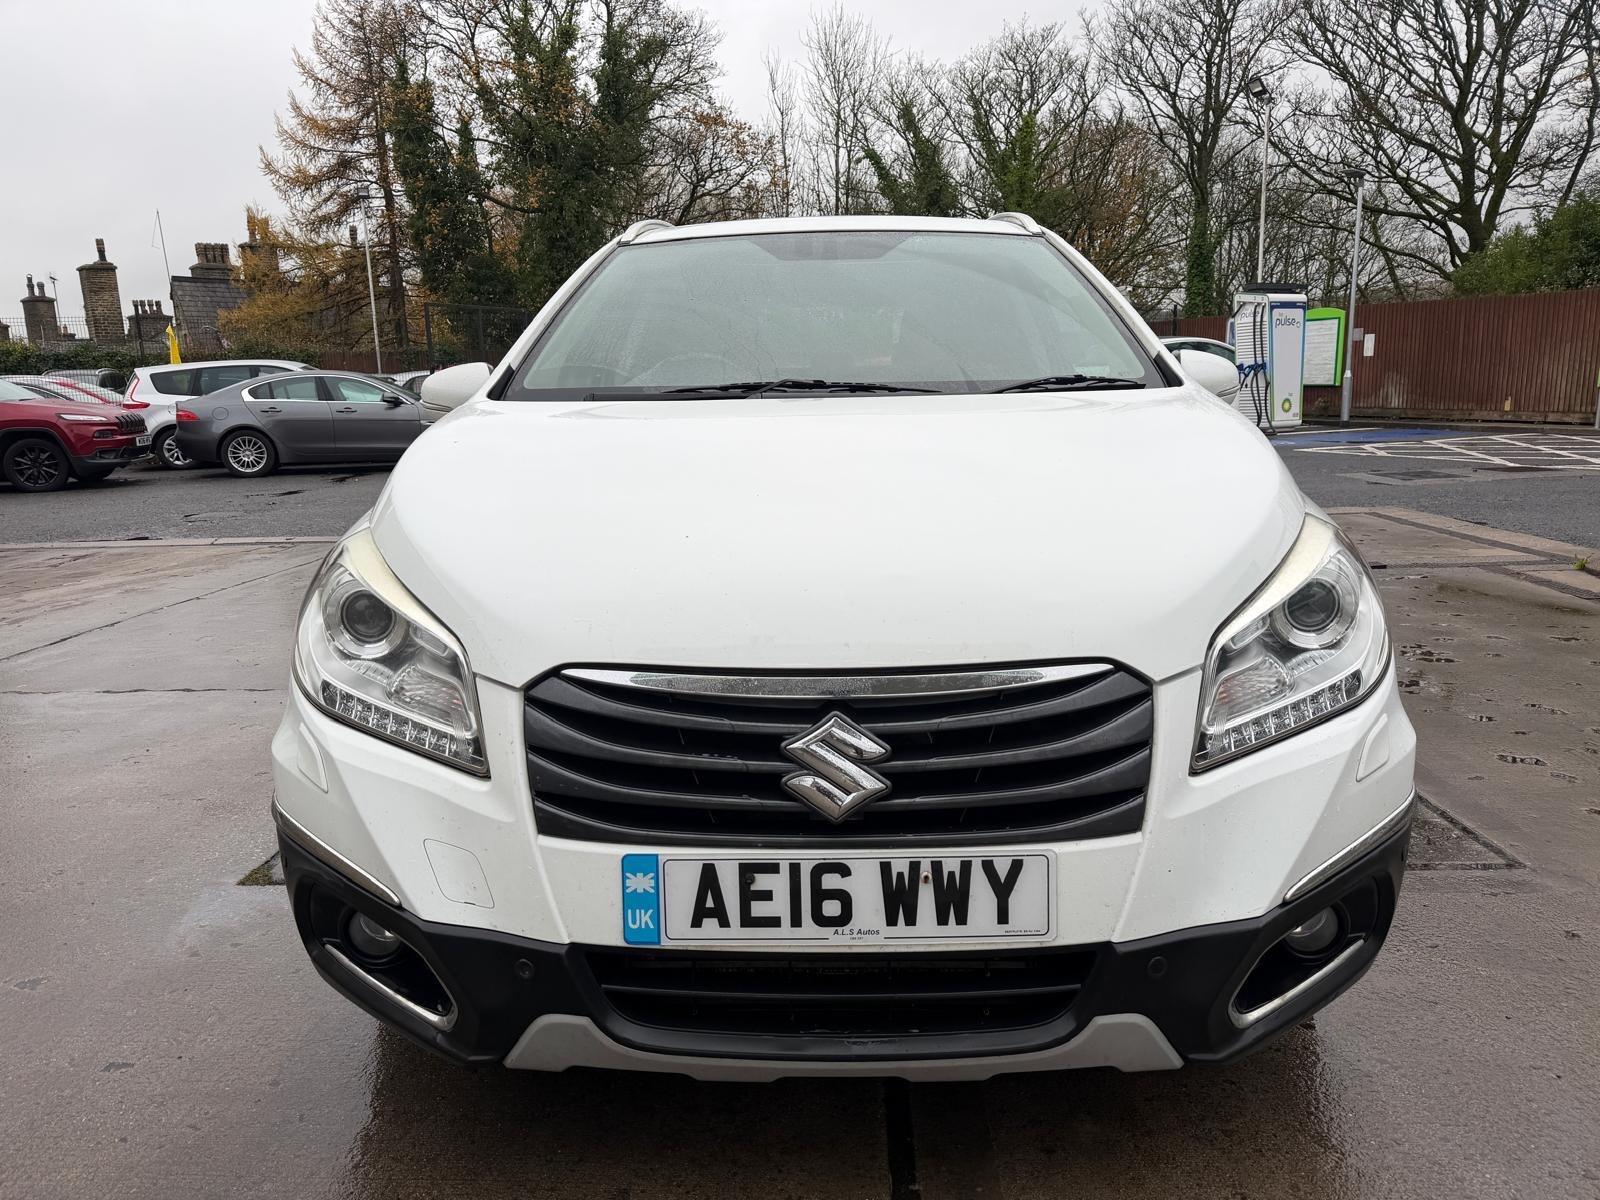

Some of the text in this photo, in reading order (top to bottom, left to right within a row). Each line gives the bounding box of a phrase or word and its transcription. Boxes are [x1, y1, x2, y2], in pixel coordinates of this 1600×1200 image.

[1240, 309, 1260, 321] pule
[1275, 315, 1296, 328] pulse
[690, 859, 1024, 929] AE16 WWY
[628, 909, 654, 929] UK
[833, 928, 880, 936] A.L.S Autos
